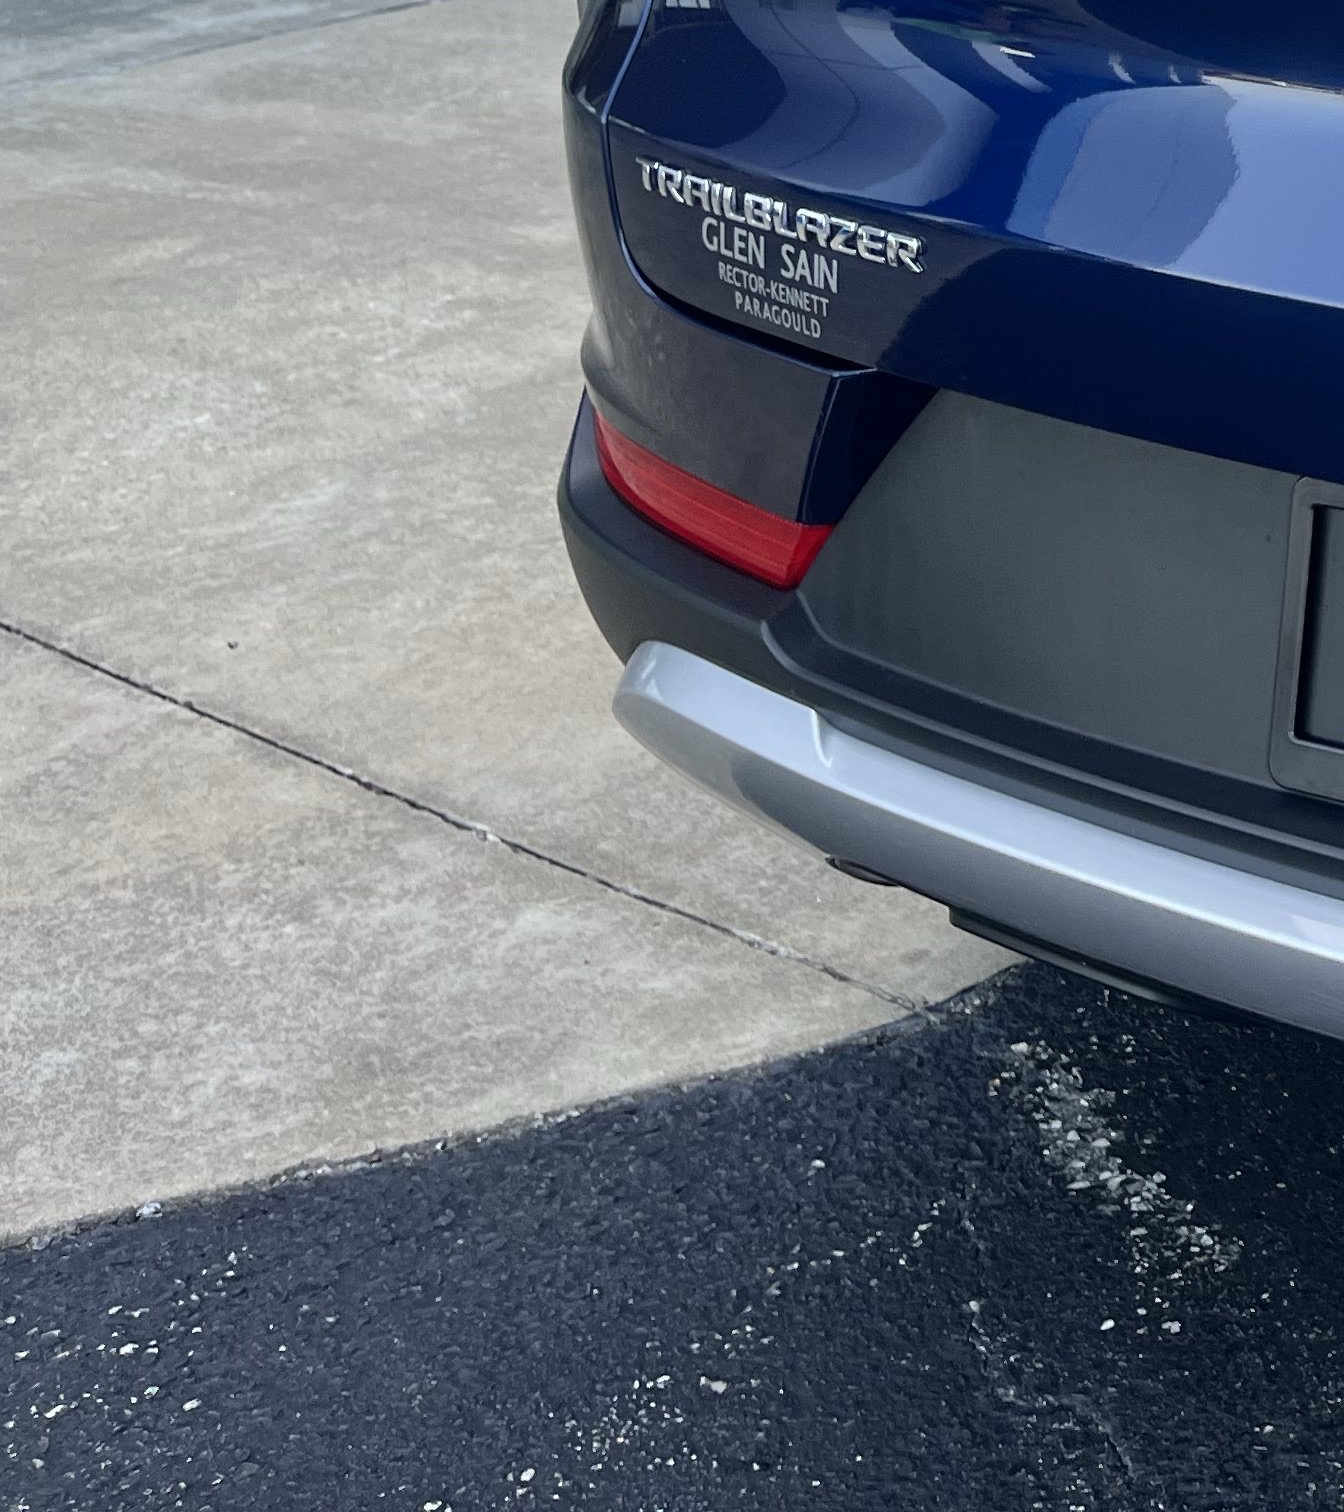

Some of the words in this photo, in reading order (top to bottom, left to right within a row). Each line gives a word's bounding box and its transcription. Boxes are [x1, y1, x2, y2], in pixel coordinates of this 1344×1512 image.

[635, 155, 927, 274] TRAILBLAZER
[701, 216, 766, 270] GLEN
[780, 243, 839, 294] SAIN
[717, 261, 830, 318] RECTOR-KENNETT
[735, 291, 822, 339] PARAGOULD
